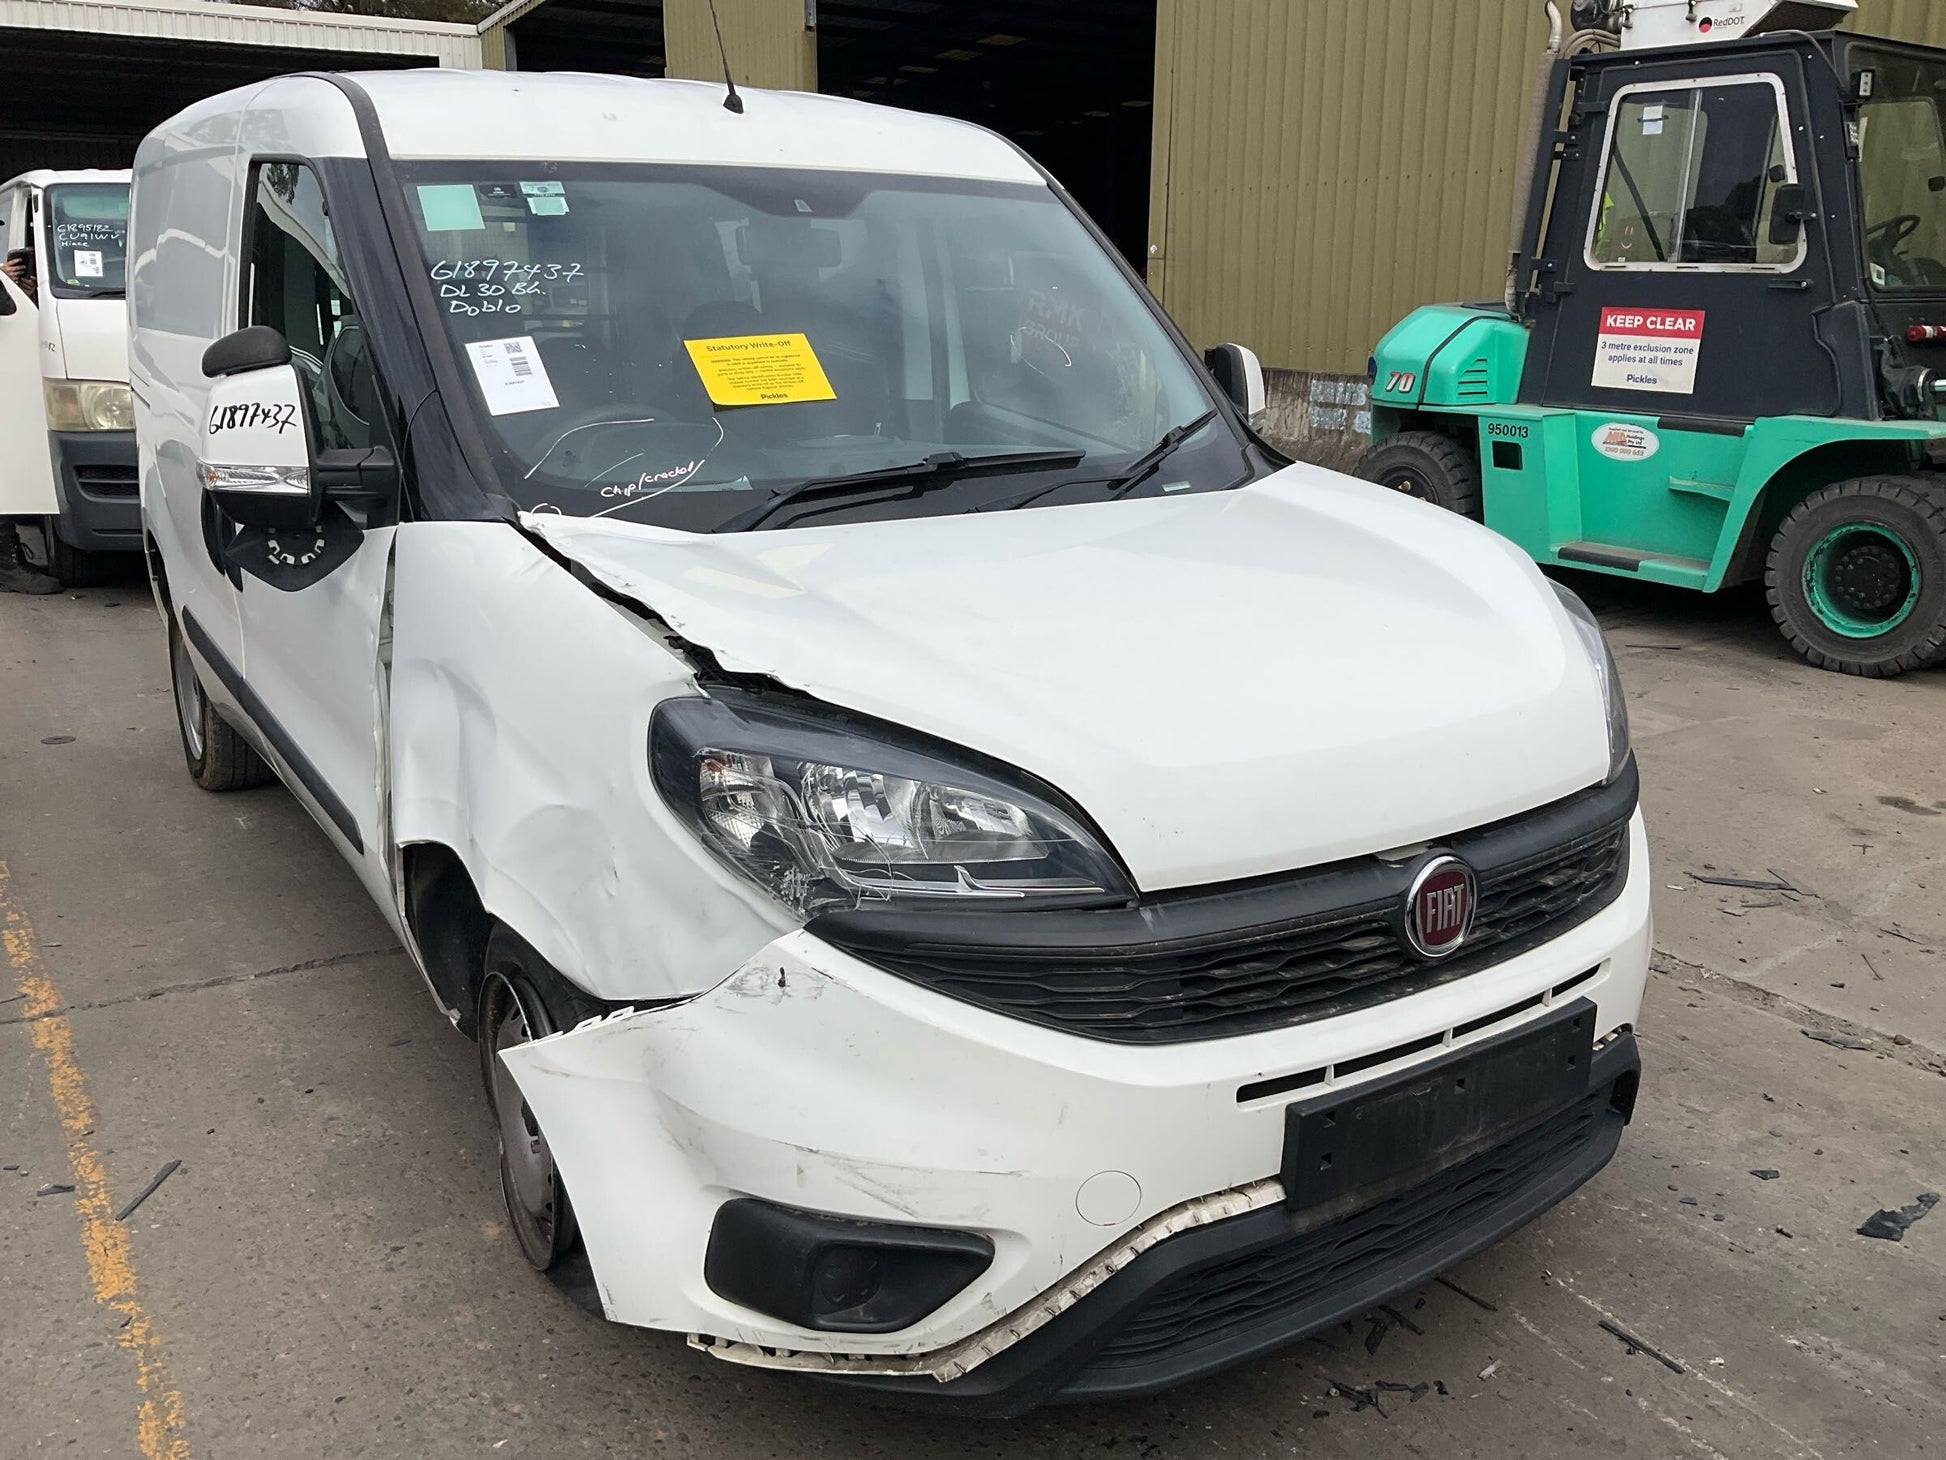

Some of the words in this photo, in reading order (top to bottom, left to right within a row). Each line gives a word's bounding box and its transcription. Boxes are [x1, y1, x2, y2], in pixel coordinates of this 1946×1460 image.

[1713, 16, 1745, 27] RedDOT
[430, 259, 585, 283] 61897437
[449, 299, 522, 316] Doblo
[1606, 314, 1644, 329] KEEP
[1646, 316, 1696, 331] CLEAR
[705, 343, 749, 352] Statutory
[750, 340, 791, 349] Write-Off
[1601, 340, 1607, 350] 3
[1608, 342, 1632, 351] metre
[1633, 343, 1672, 353] exclusion
[1674, 346, 1694, 355] zone
[1608, 354, 1636, 364] applies
[1638, 356, 1647, 364] at
[1648, 356, 1659, 365] all
[1660, 357, 1683, 367] times
[1385, 371, 1416, 393] 70
[1626, 373, 1658, 385] Pickles
[760, 392, 788, 400] Pickles
[208, 402, 297, 435] 61897437
[1487, 422, 1529, 439] 950013
[1426, 883, 1465, 934] FIAT
